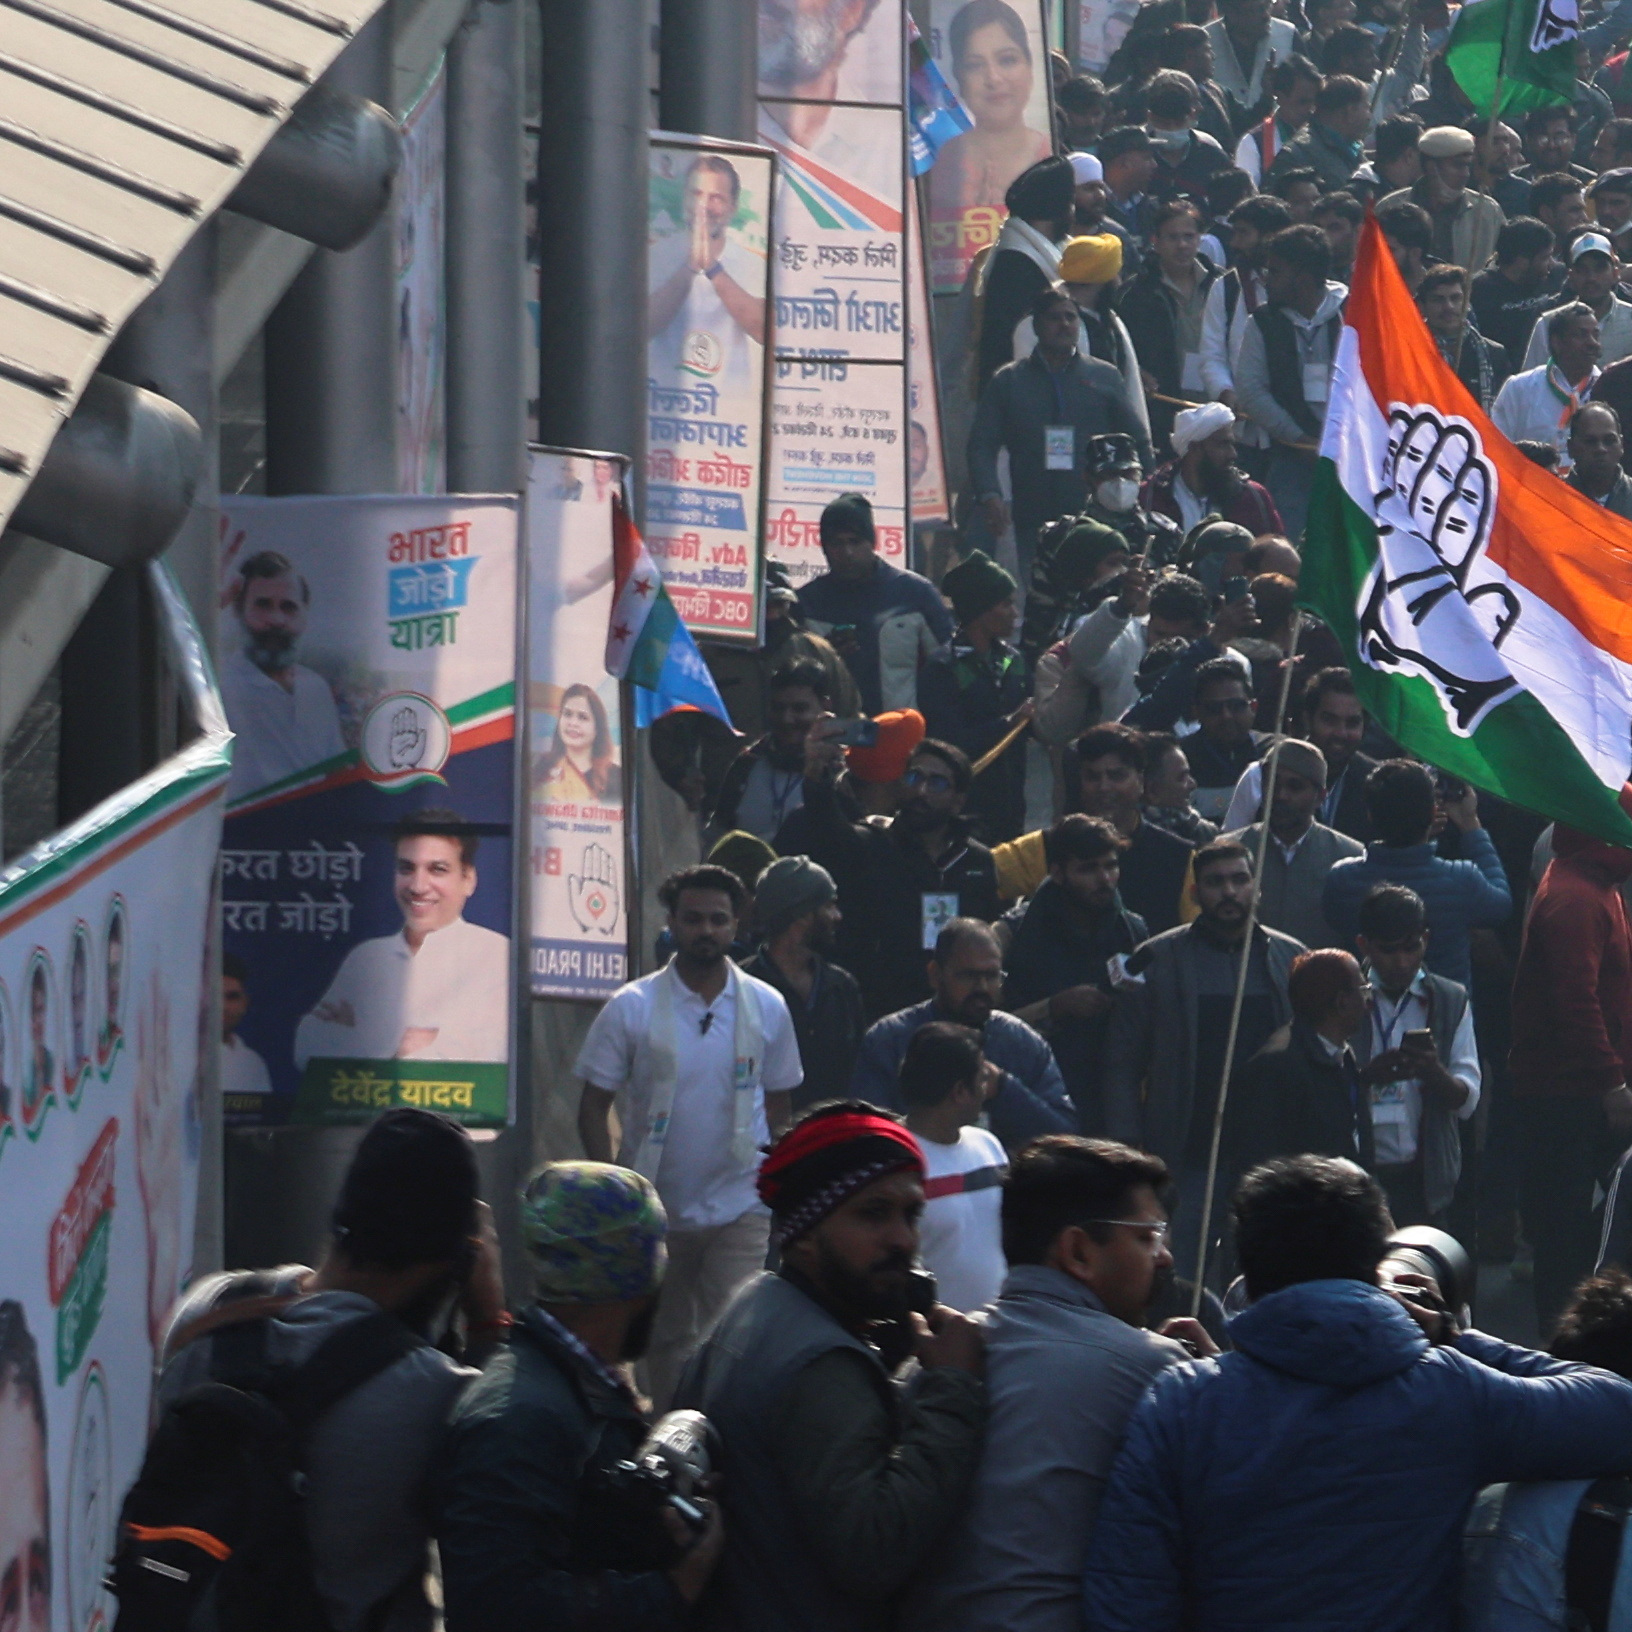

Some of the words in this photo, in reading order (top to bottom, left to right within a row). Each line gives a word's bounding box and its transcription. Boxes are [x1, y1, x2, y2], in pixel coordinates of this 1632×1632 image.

[388, 521, 472, 563] भारत
[393, 564, 459, 608] जोड़ो
[387, 611, 459, 651] यात्रा
[290, 840, 365, 890] छोड़ो
[277, 893, 353, 941] जोड़ो
[331, 1071, 391, 1106] देवेंद्र
[398, 1078, 474, 1106] यादव
